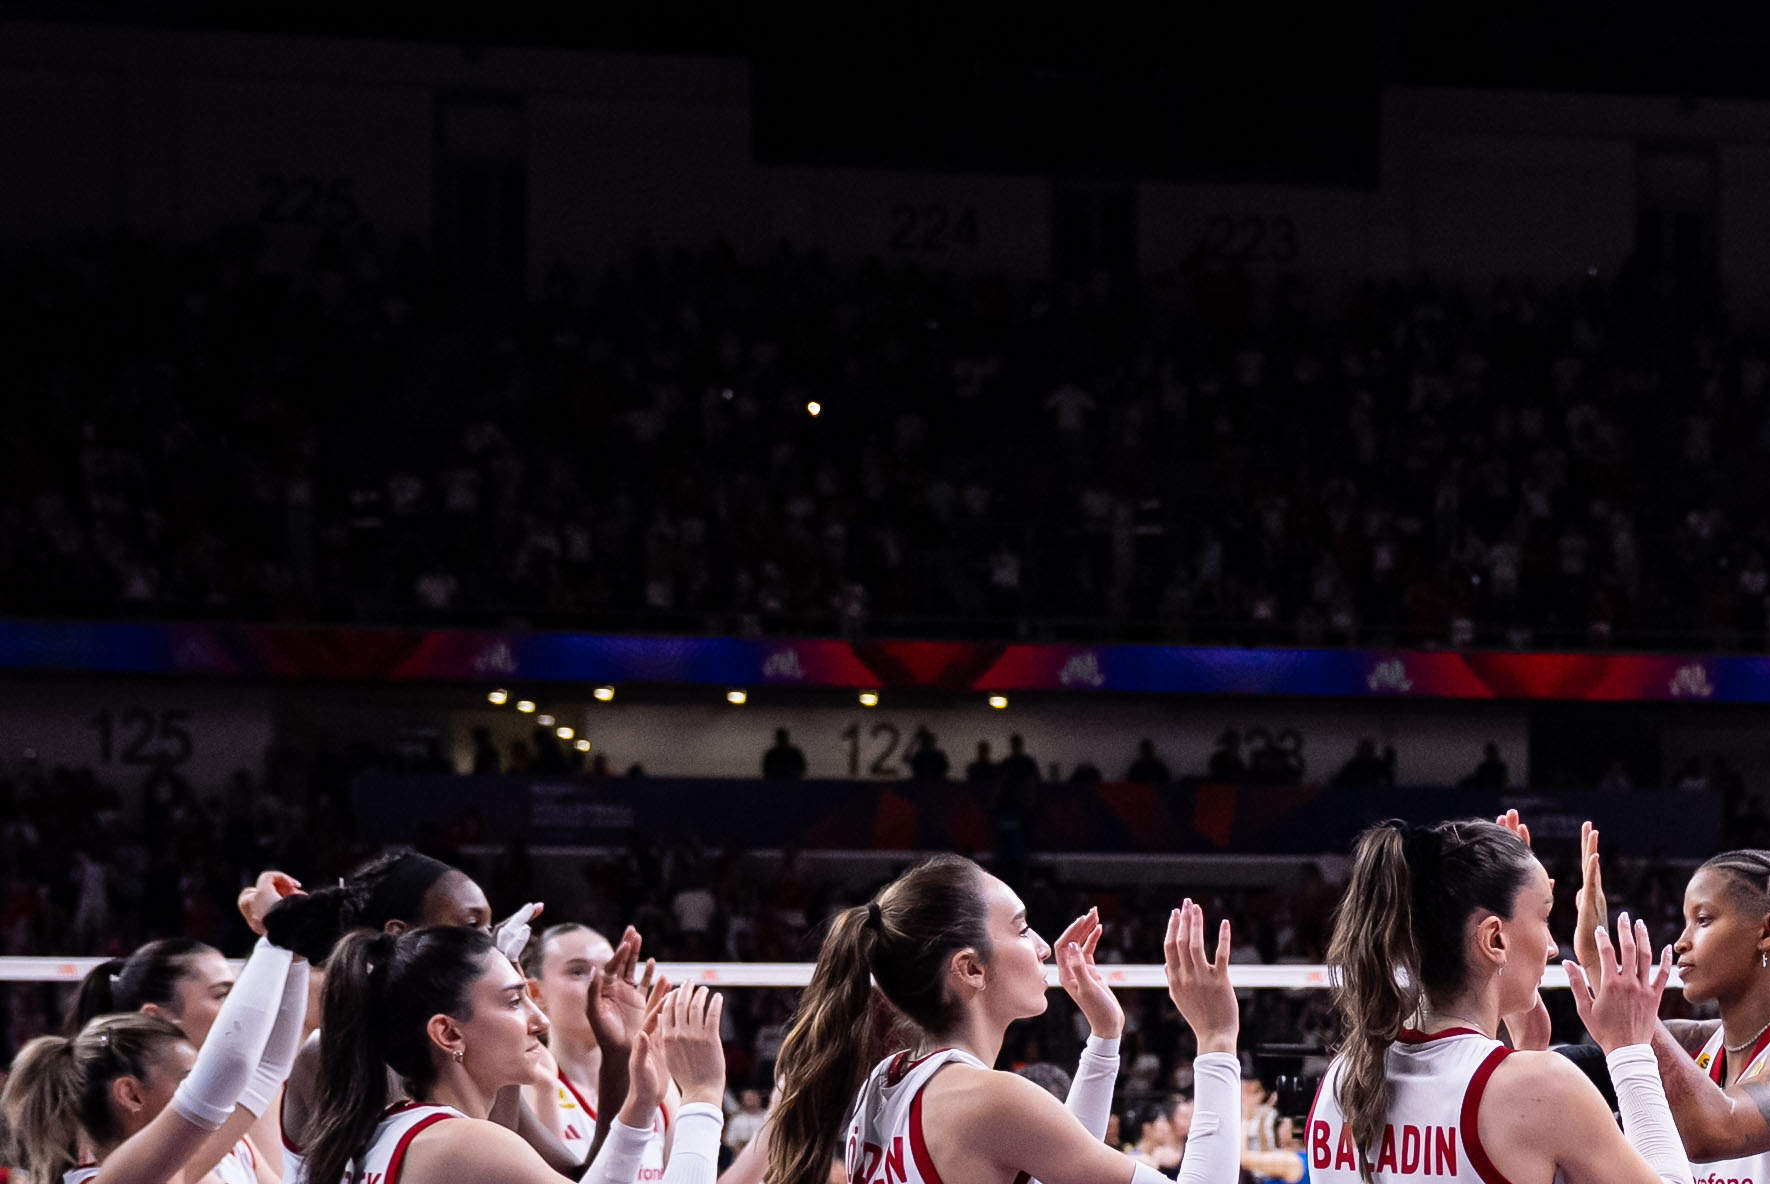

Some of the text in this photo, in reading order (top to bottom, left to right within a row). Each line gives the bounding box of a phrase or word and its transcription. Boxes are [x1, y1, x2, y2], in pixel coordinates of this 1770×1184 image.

[888, 202, 979, 251] 224
[1207, 214, 1298, 263] 223
[91, 707, 193, 766] 125
[1313, 1119, 1458, 1176] BAADIN
